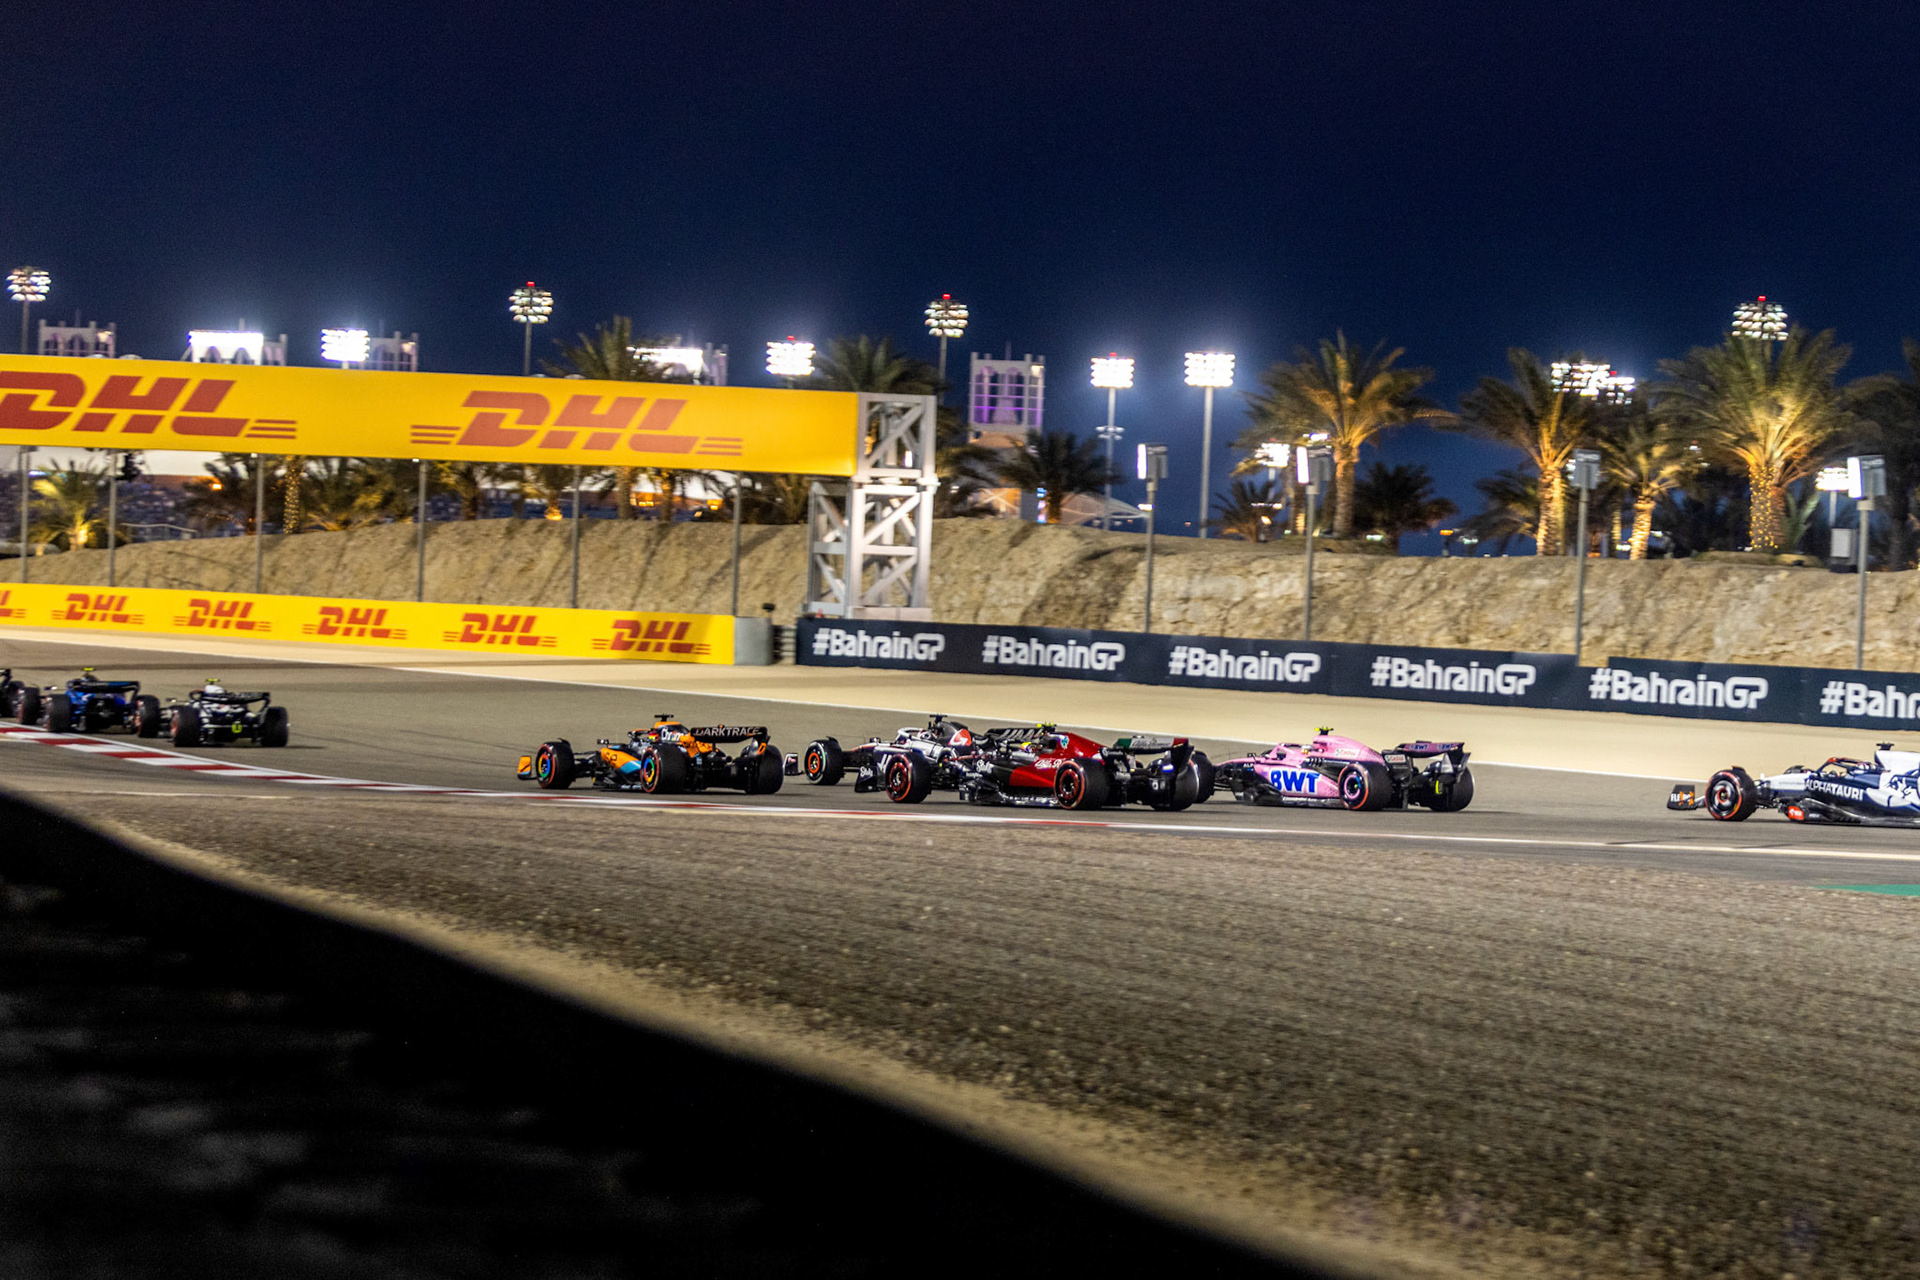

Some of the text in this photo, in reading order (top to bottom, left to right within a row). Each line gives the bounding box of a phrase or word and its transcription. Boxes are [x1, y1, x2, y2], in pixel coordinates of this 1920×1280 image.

[0, 371, 249, 438] DHL
[457, 390, 697, 454] DHL
[65, 593, 130, 626] DHL
[188, 599, 256, 632] DHL
[318, 607, 391, 640] DHL
[460, 613, 541, 647] DHL
[611, 620, 695, 655] DHL
[813, 628, 946, 661] #BahrainGP
[983, 636, 1126, 671] #BahrainGP
[1169, 645, 1321, 683] #BahrainGP
[1370, 655, 1537, 696] #BahrainGP
[1589, 667, 1769, 710] #BahrainGP
[694, 726, 762, 737] DARKTRACE
[1270, 769, 1321, 794] BWT
[1804, 779, 1865, 802] ALPHATAURI
